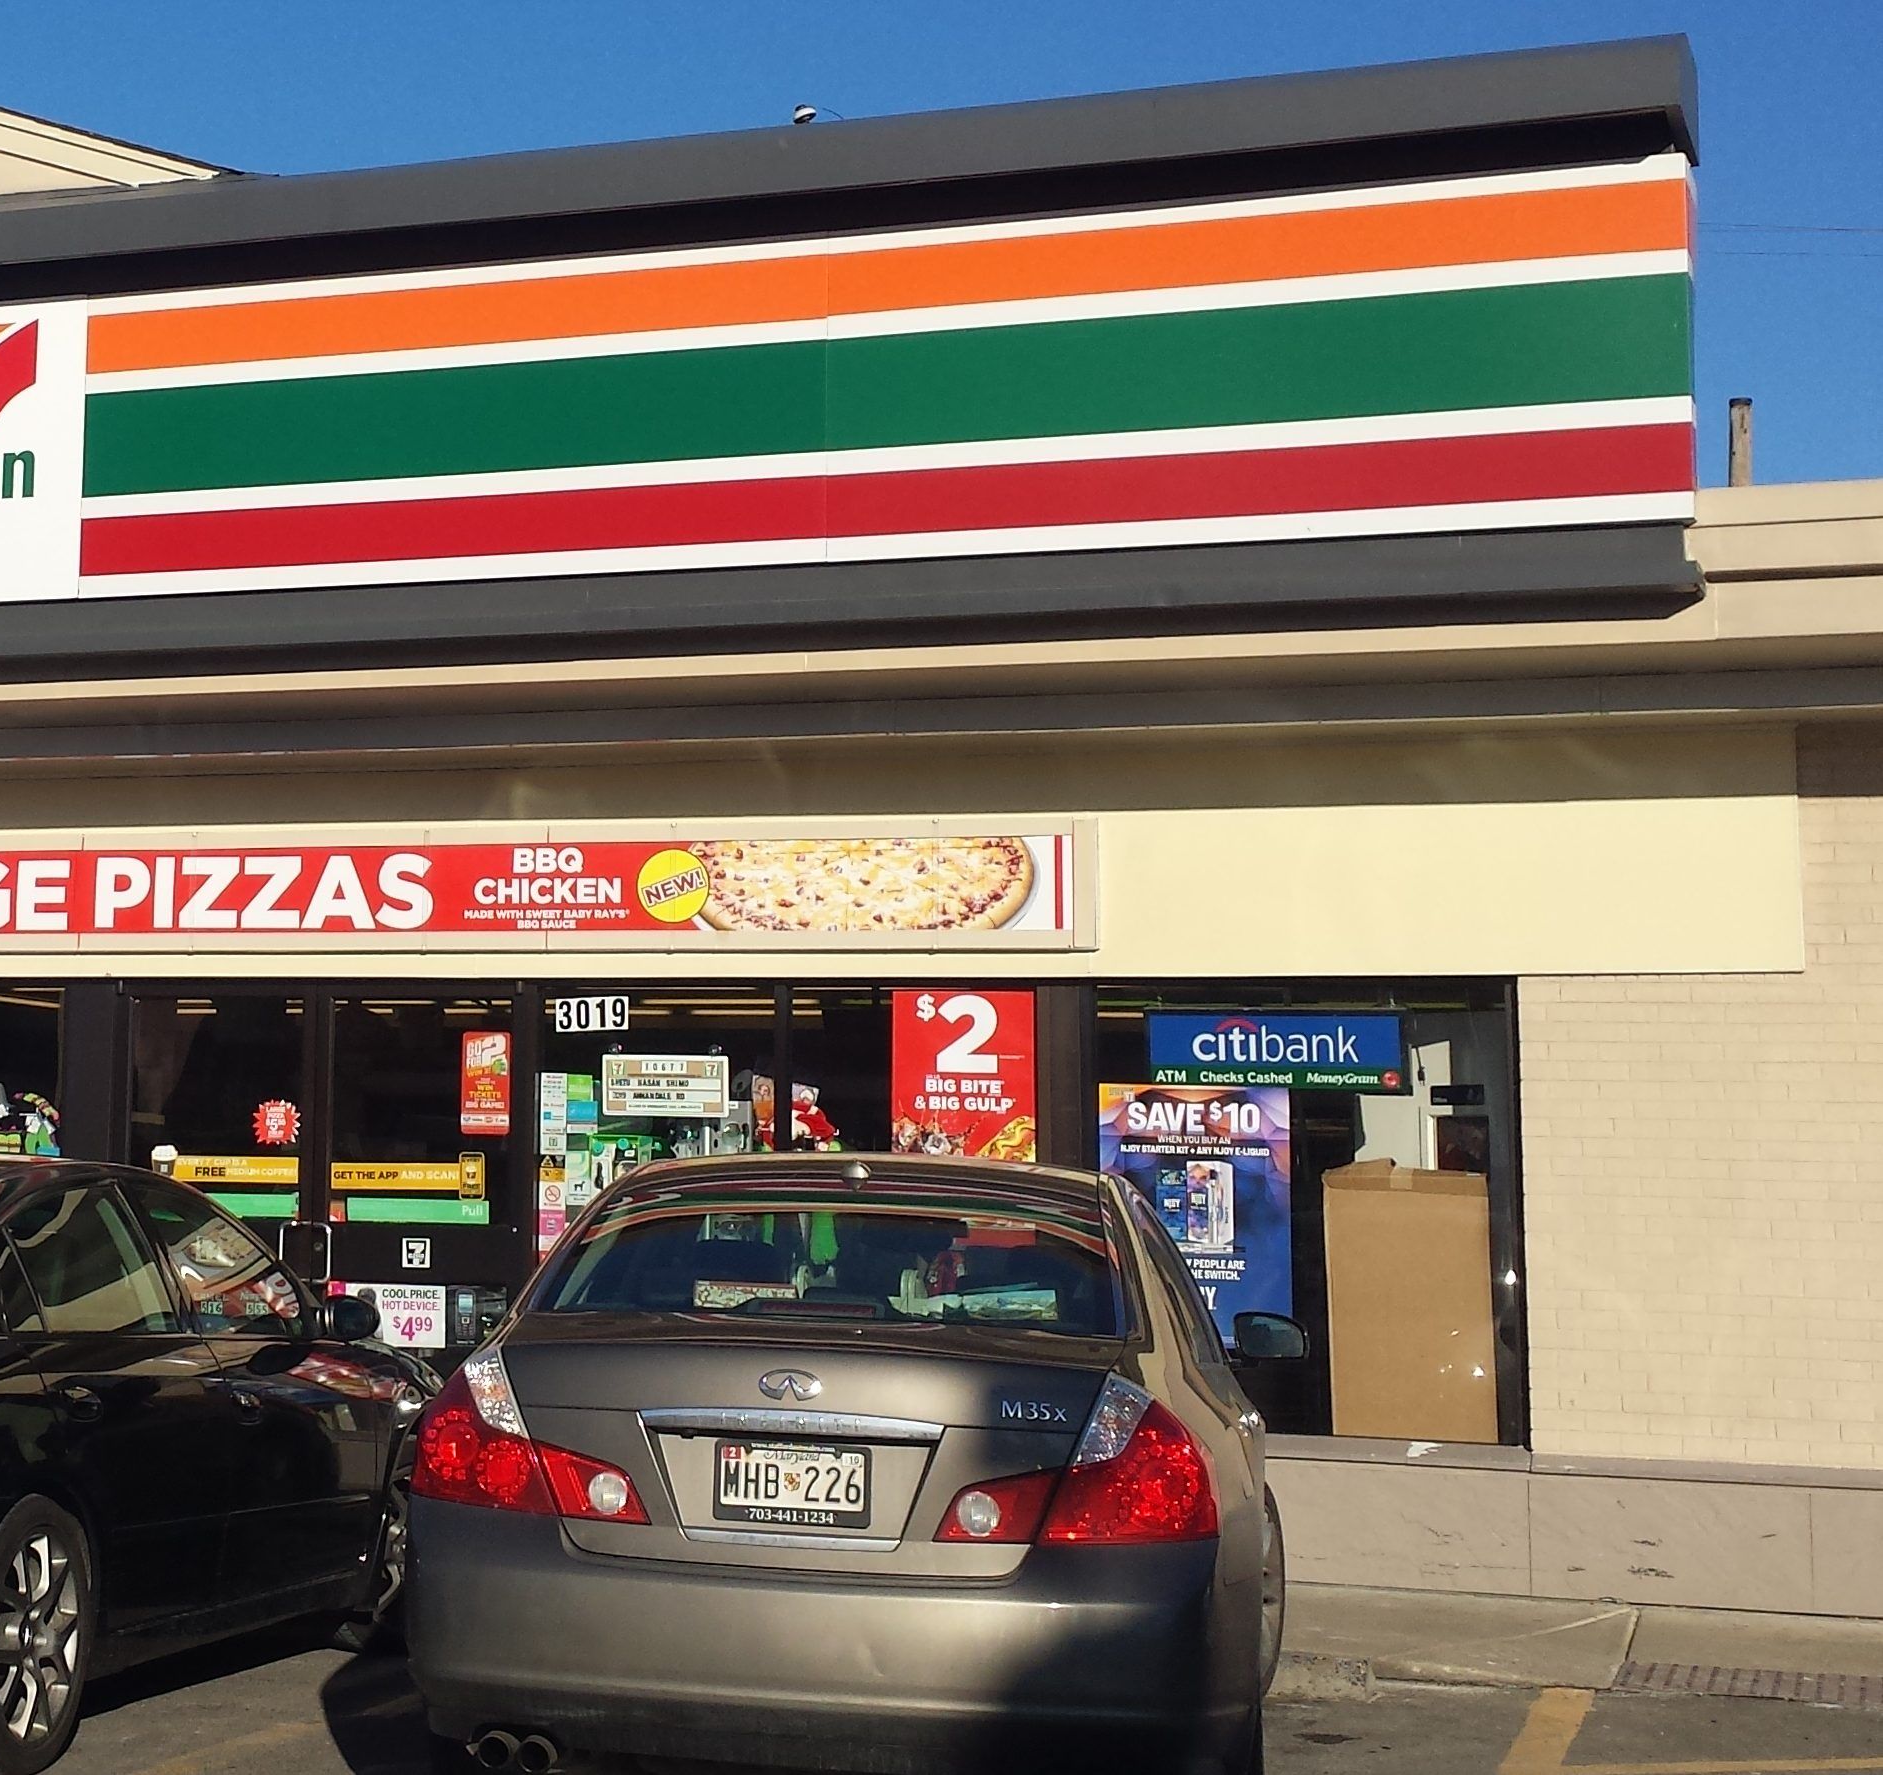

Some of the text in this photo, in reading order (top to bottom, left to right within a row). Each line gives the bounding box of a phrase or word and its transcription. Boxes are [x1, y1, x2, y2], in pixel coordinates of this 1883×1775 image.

[512, 847, 584, 874] BBQ
[93, 853, 435, 930] PIZZAS
[473, 877, 622, 905] CHICKEN
[641, 867, 708, 907] NEW!
[464, 909, 494, 920] MADE
[495, 909, 523, 919] WITH
[525, 909, 562, 919] SWEET
[563, 909, 592, 919] BABY
[517, 920, 576, 929] BBQ SAUCE
[558, 999, 626, 1030] 3019
[916, 994, 998, 1073] $2
[1192, 1025, 1359, 1063] citibank
[1156, 1070, 1187, 1083] ATM
[1200, 1071, 1244, 1083] Checks
[1247, 1071, 1293, 1084] Cashed
[925, 1079, 1001, 1094] BIG BITE
[469, 1091, 502, 1099] TICKETS
[914, 1095, 1013, 1112] & BIG GULP
[1127, 1101, 1261, 1134] SAVE $10
[1157, 1135, 1231, 1145] WHEN YOU BUY AN
[1120, 1144, 1270, 1156] NJOY STARTER KIT ANY NJOY E-LIQUID
[194, 1167, 226, 1177] FREE
[333, 1171, 353, 1180] GET
[356, 1171, 376, 1180] THE
[377, 1171, 399, 1180] APP
[401, 1171, 425, 1180] AND
[462, 1205, 484, 1216] Pull
[1194, 1259, 1226, 1270] PEOPLE
[1227, 1261, 1245, 1270] ARE
[1191, 1270, 1240, 1280] HE SWITCH.
[382, 1289, 409, 1299] COOL
[382, 1301, 402, 1311] HOT
[729, 1447, 737, 1457] 2
[764, 1451, 820, 1465] Maryland
[723, 1460, 861, 1505] MHB 226
[748, 1508, 834, 1524] 703-441-1234
